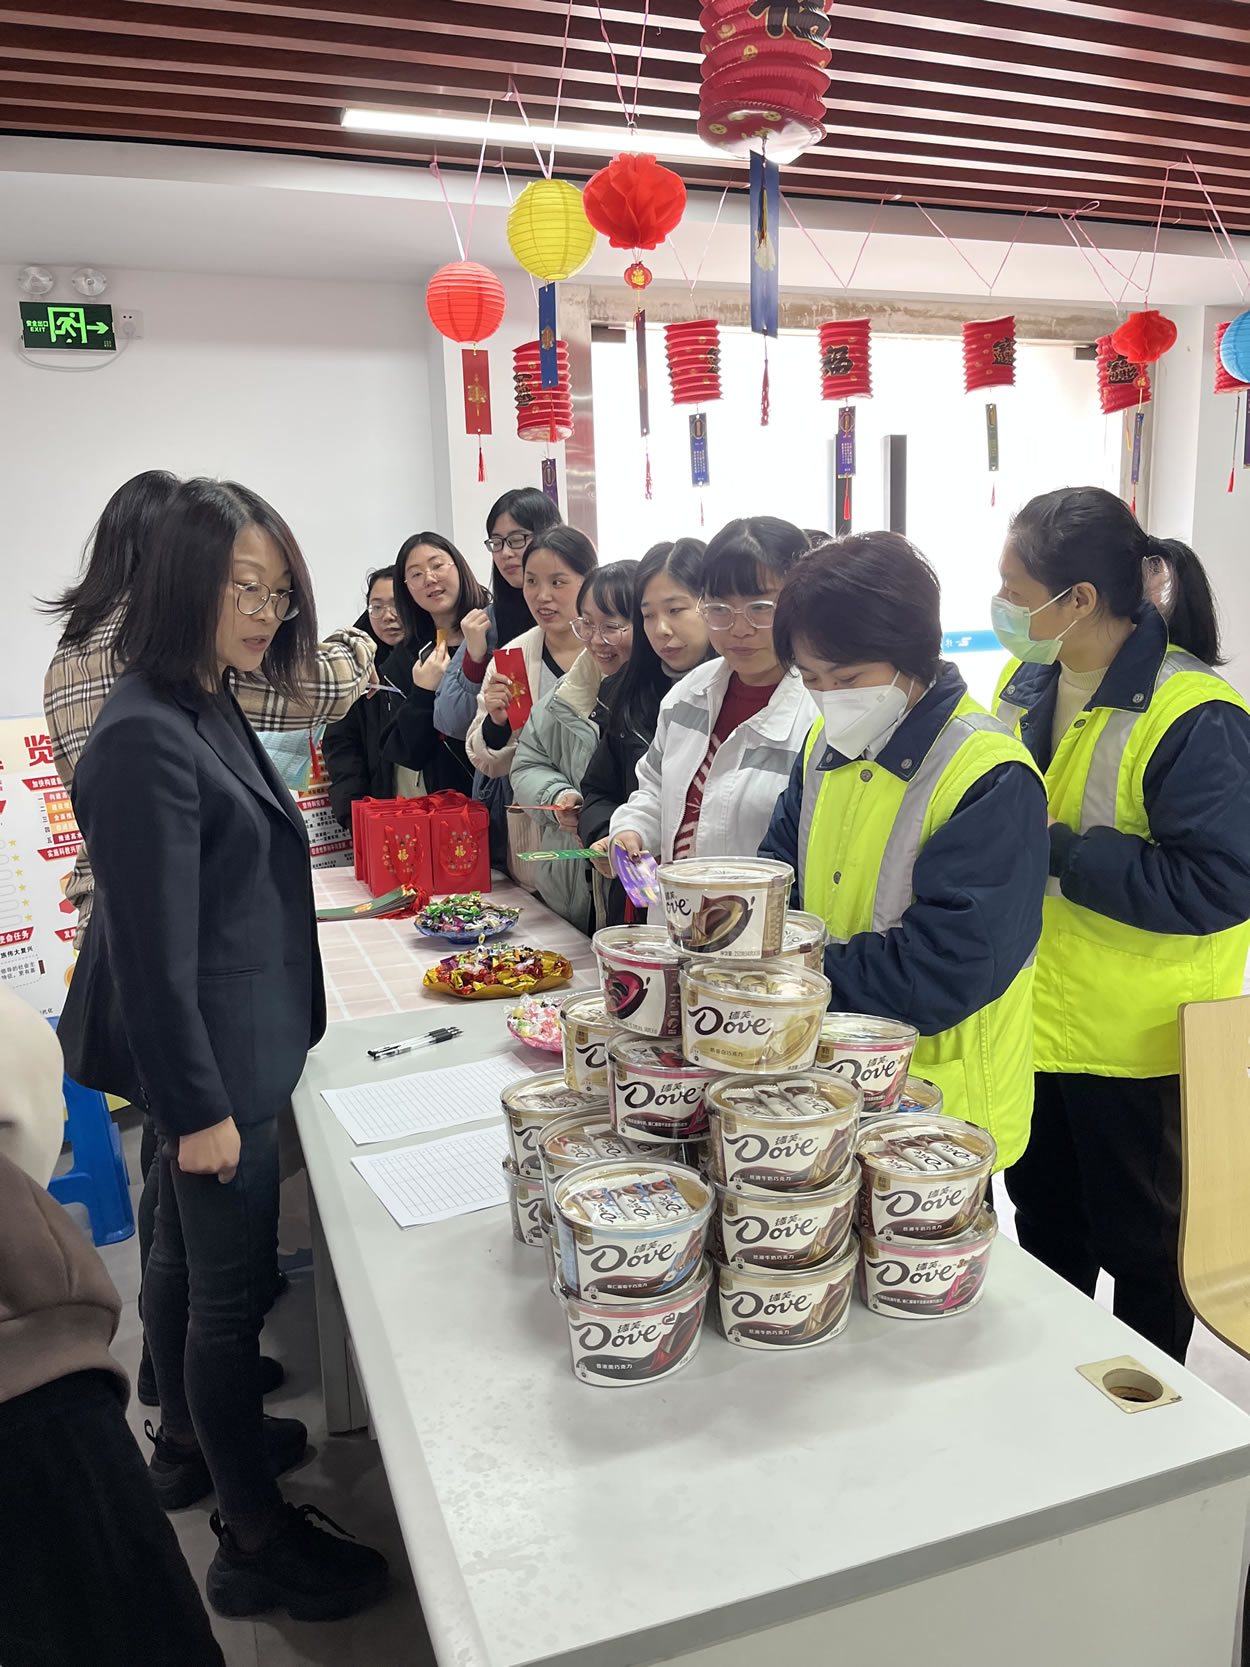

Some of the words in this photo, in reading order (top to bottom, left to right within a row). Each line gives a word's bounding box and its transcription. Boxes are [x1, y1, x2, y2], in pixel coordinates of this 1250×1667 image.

[666, 898, 691, 916] ove
[688, 1006, 771, 1035] Dove
[729, 1010, 752, 1020] 德芙
[816, 1059, 897, 1081] Dove
[867, 1055, 887, 1067] 德芙
[616, 1081, 701, 1109] Dove
[661, 1082, 682, 1093] 德芙
[775, 1133, 799, 1145] 德芙
[724, 1134, 818, 1163] Dove
[928, 1186, 950, 1199] 德芙
[874, 1189, 965, 1217] Dove
[775, 1214, 799, 1226] 德芙
[724, 1215, 818, 1244] Dove
[634, 1240, 658, 1254] 德芙
[578, 1243, 676, 1273] Dove
[916, 1260, 939, 1271] 德芙
[867, 1260, 957, 1286] Dove
[720, 1291, 812, 1318] Dove
[769, 1291, 792, 1302] 德芙
[617, 1321, 642, 1333] 德芙
[570, 1322, 661, 1351] Dove
